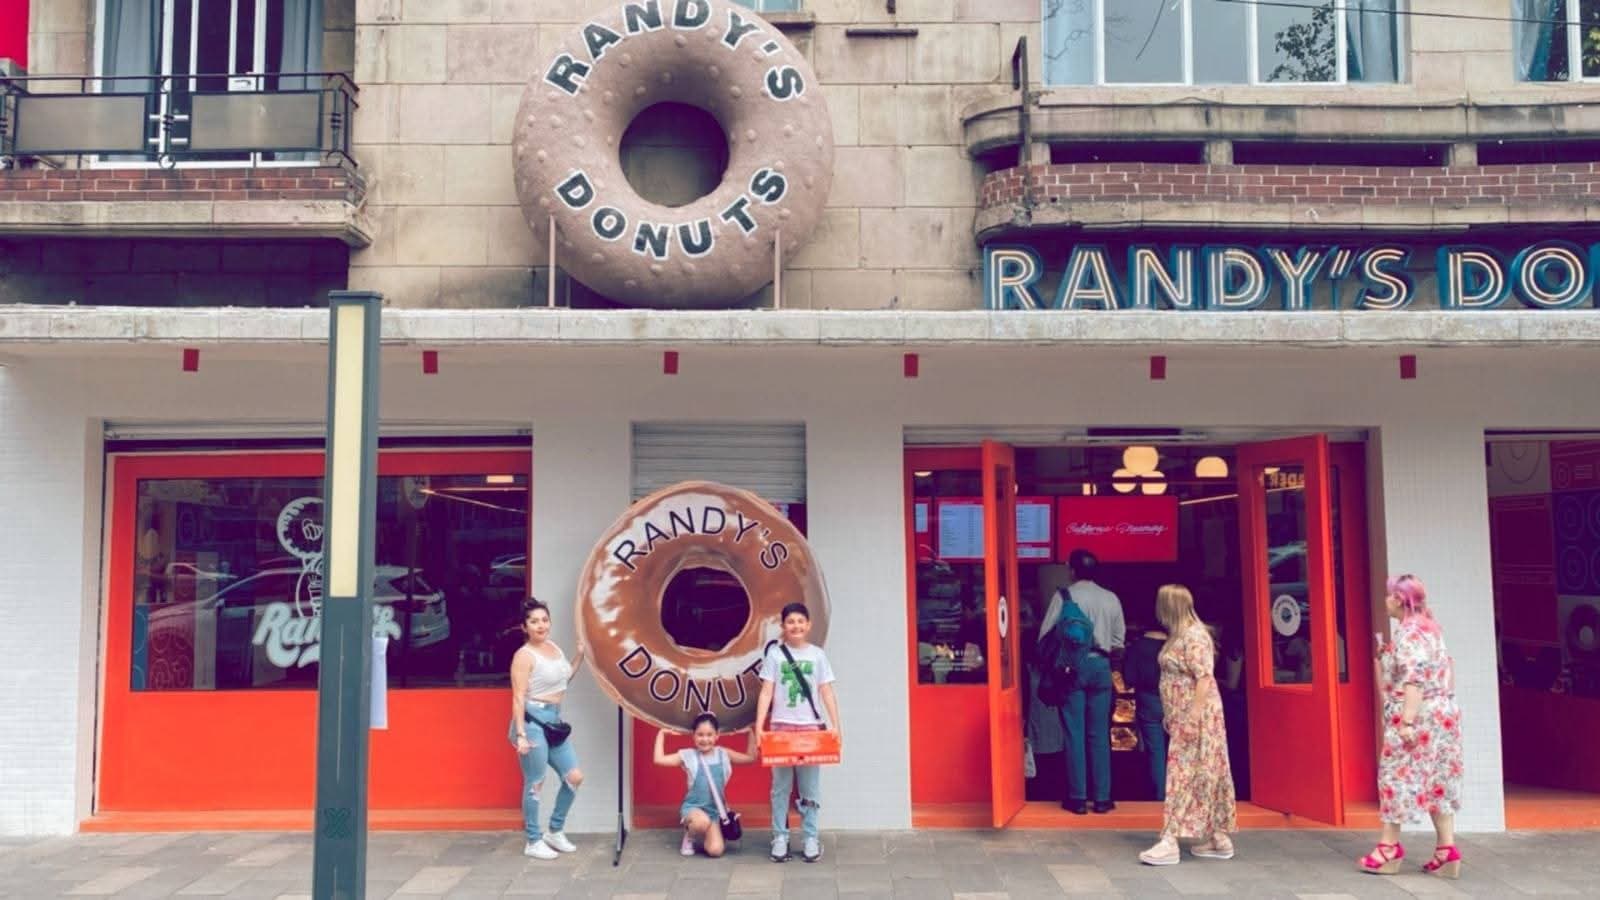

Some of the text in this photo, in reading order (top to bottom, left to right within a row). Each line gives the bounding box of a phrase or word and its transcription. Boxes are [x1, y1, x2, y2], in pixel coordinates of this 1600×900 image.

[546, 0, 805, 100] RANDY'S
[555, 168, 788, 260] DONUTS
[983, 240, 1600, 311] RANDY'S DO
[613, 506, 788, 571] RANDY'S
